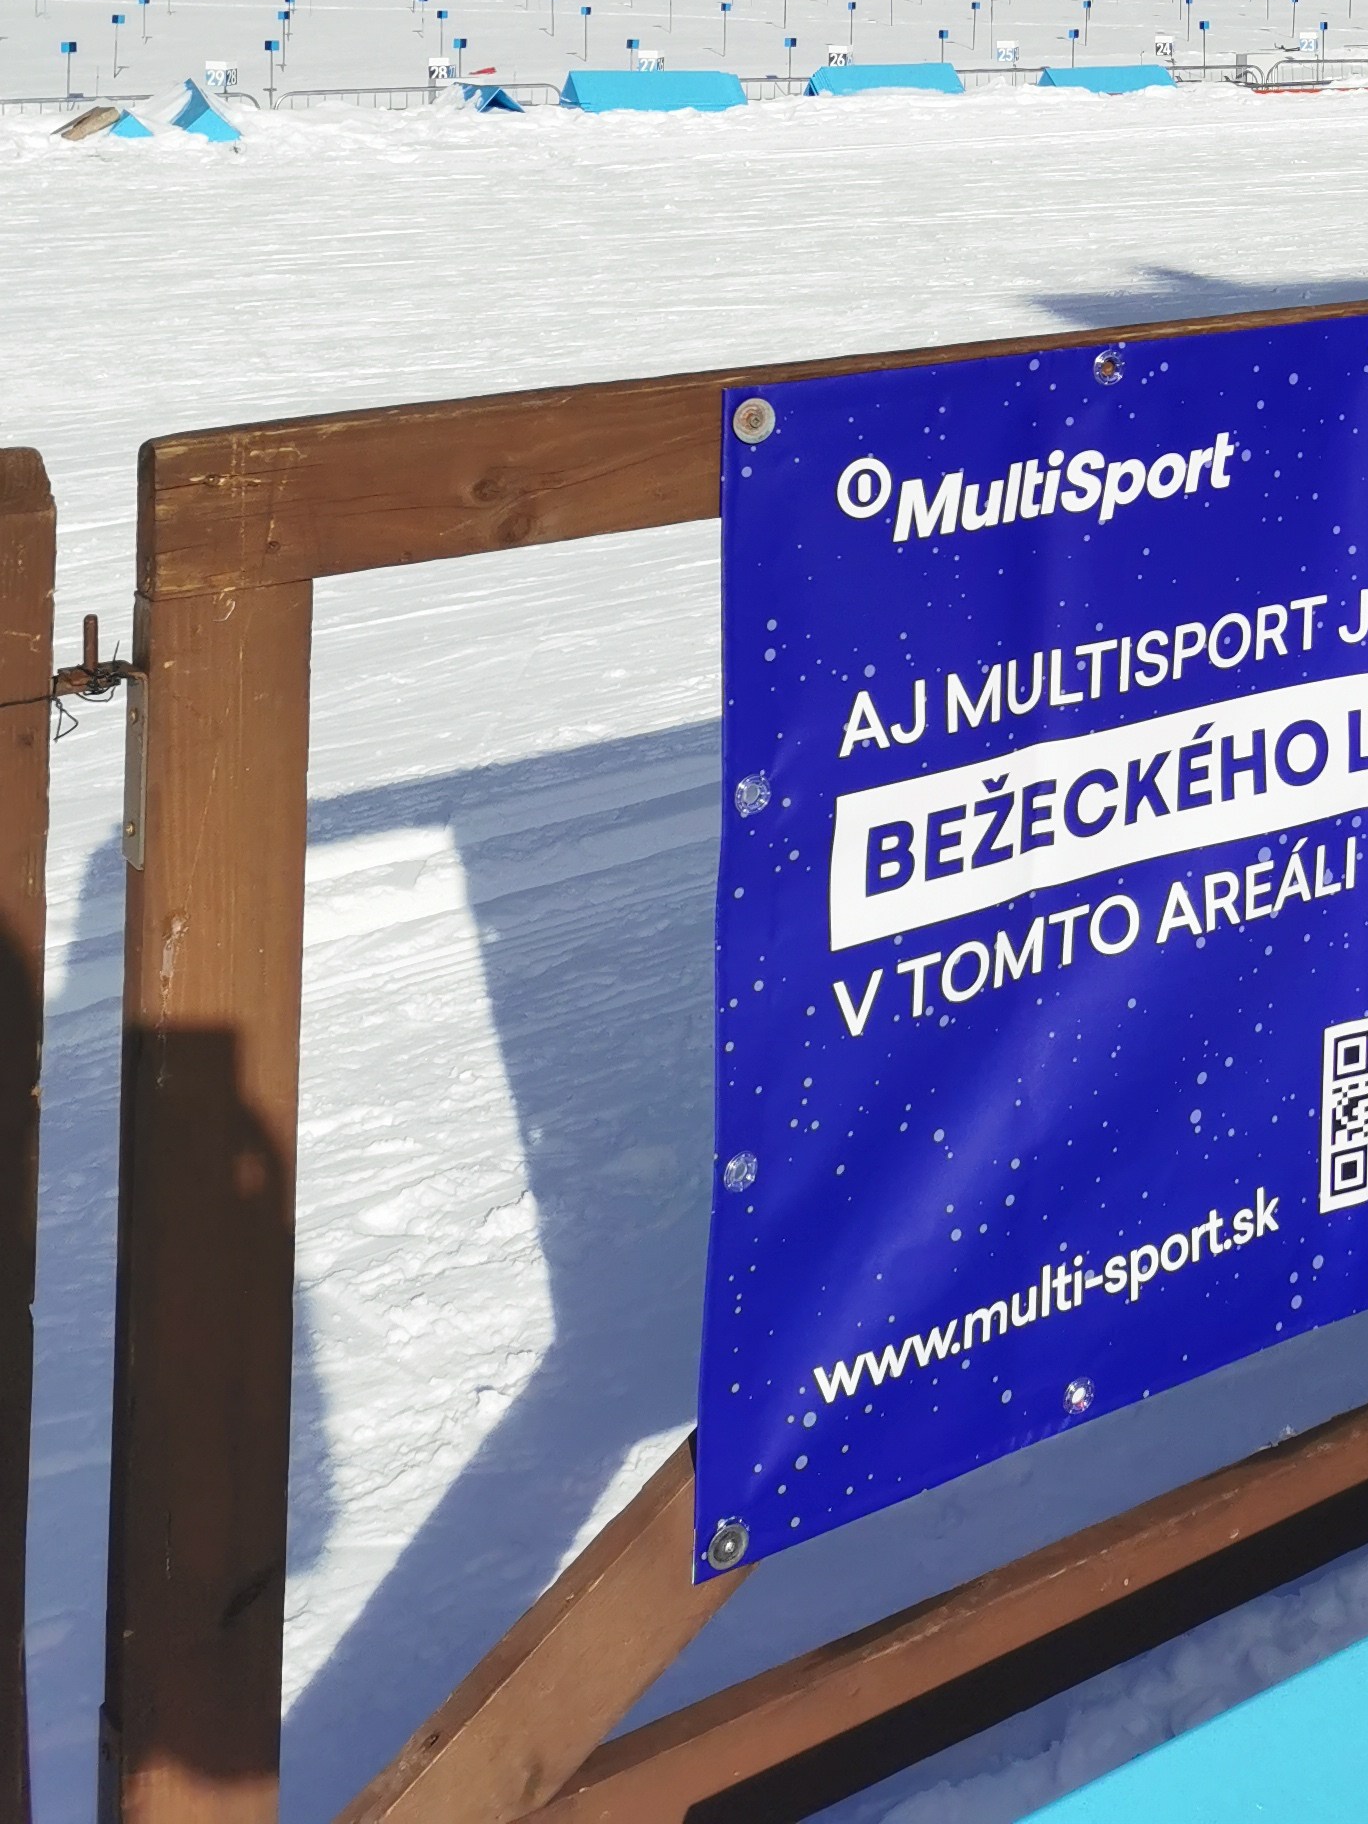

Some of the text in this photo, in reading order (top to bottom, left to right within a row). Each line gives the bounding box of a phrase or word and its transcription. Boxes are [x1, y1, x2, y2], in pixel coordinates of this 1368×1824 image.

[1156, 42, 1171, 56] 24
[1300, 38, 1315, 52] 23
[830, 53, 845, 67] 26
[998, 48, 1013, 62] 25
[430, 65, 448, 79] 28
[640, 58, 656, 72] 27
[207, 69, 225, 86] 29
[227, 69, 237, 86] 28
[893, 432, 1235, 543] MultiSport
[838, 679, 926, 758] AJ
[947, 594, 1328, 733] MULTISPORT
[865, 719, 1329, 898] BEŽECKÉHO
[832, 836, 1357, 1037] V TOMTO AREÁLI
[813, 1186, 1280, 1404] www.multi-sport.sk
